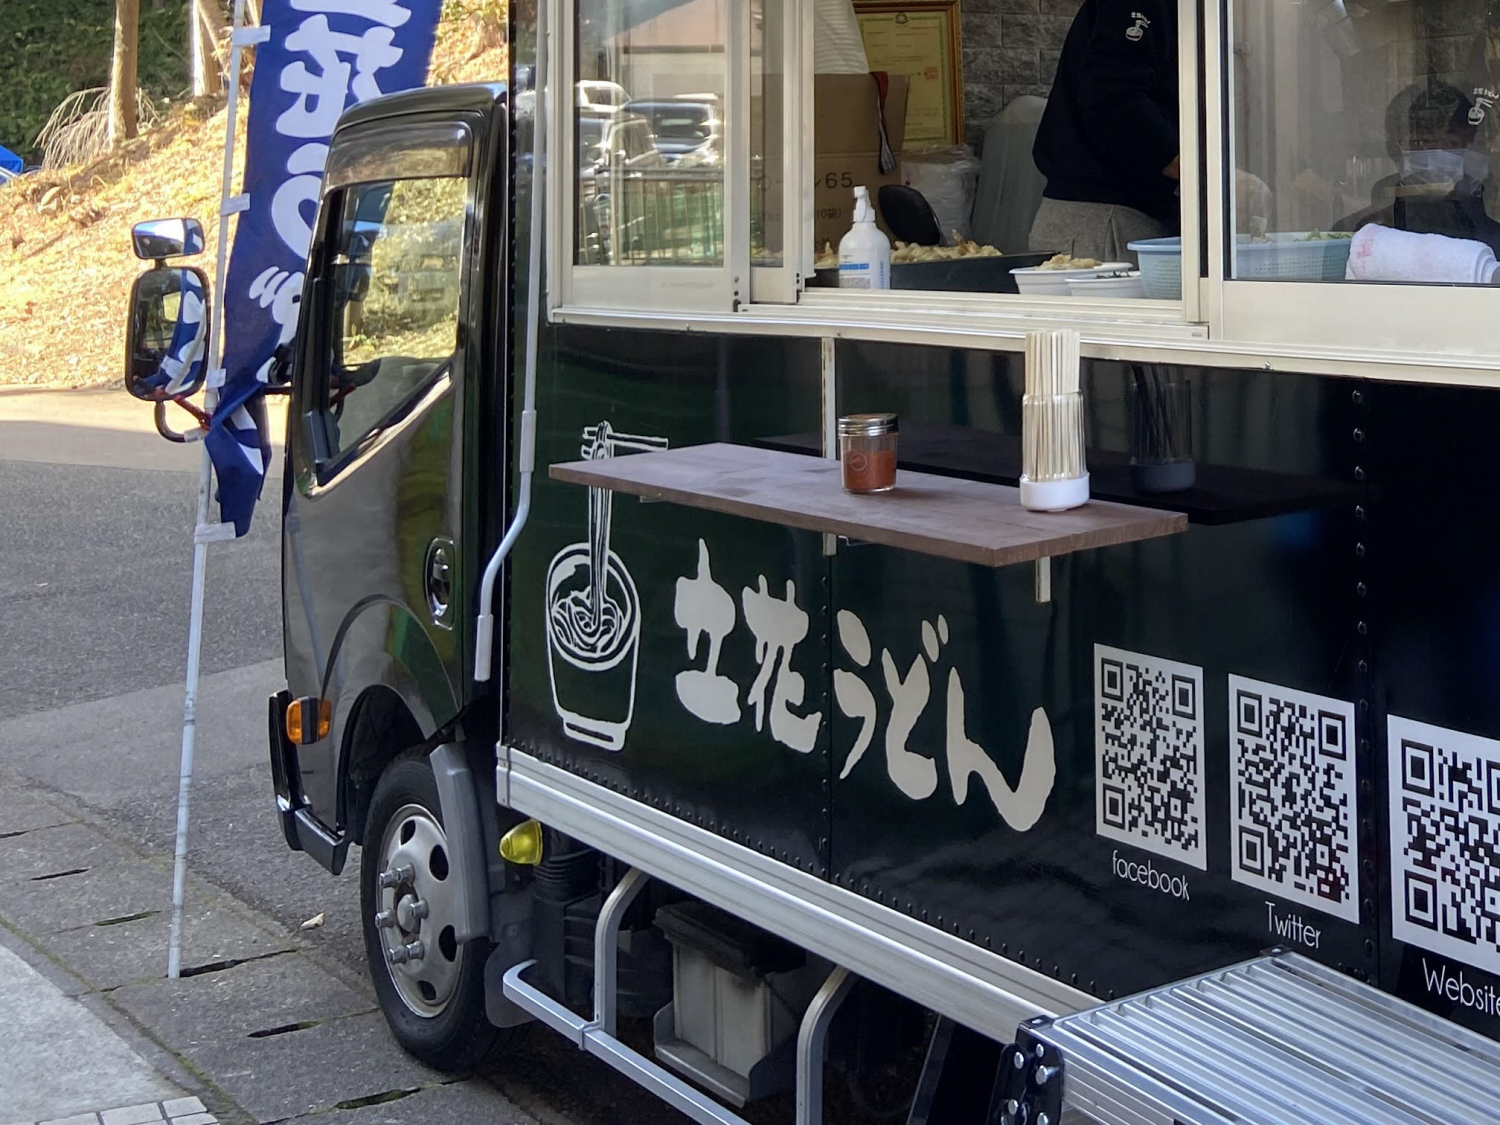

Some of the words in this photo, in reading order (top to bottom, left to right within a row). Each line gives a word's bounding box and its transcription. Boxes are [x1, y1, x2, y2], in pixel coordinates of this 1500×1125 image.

[674, 537, 1055, 832] 立花うどん
[1111, 848, 1191, 902] facebook
[1264, 901, 1323, 951] Twitter
